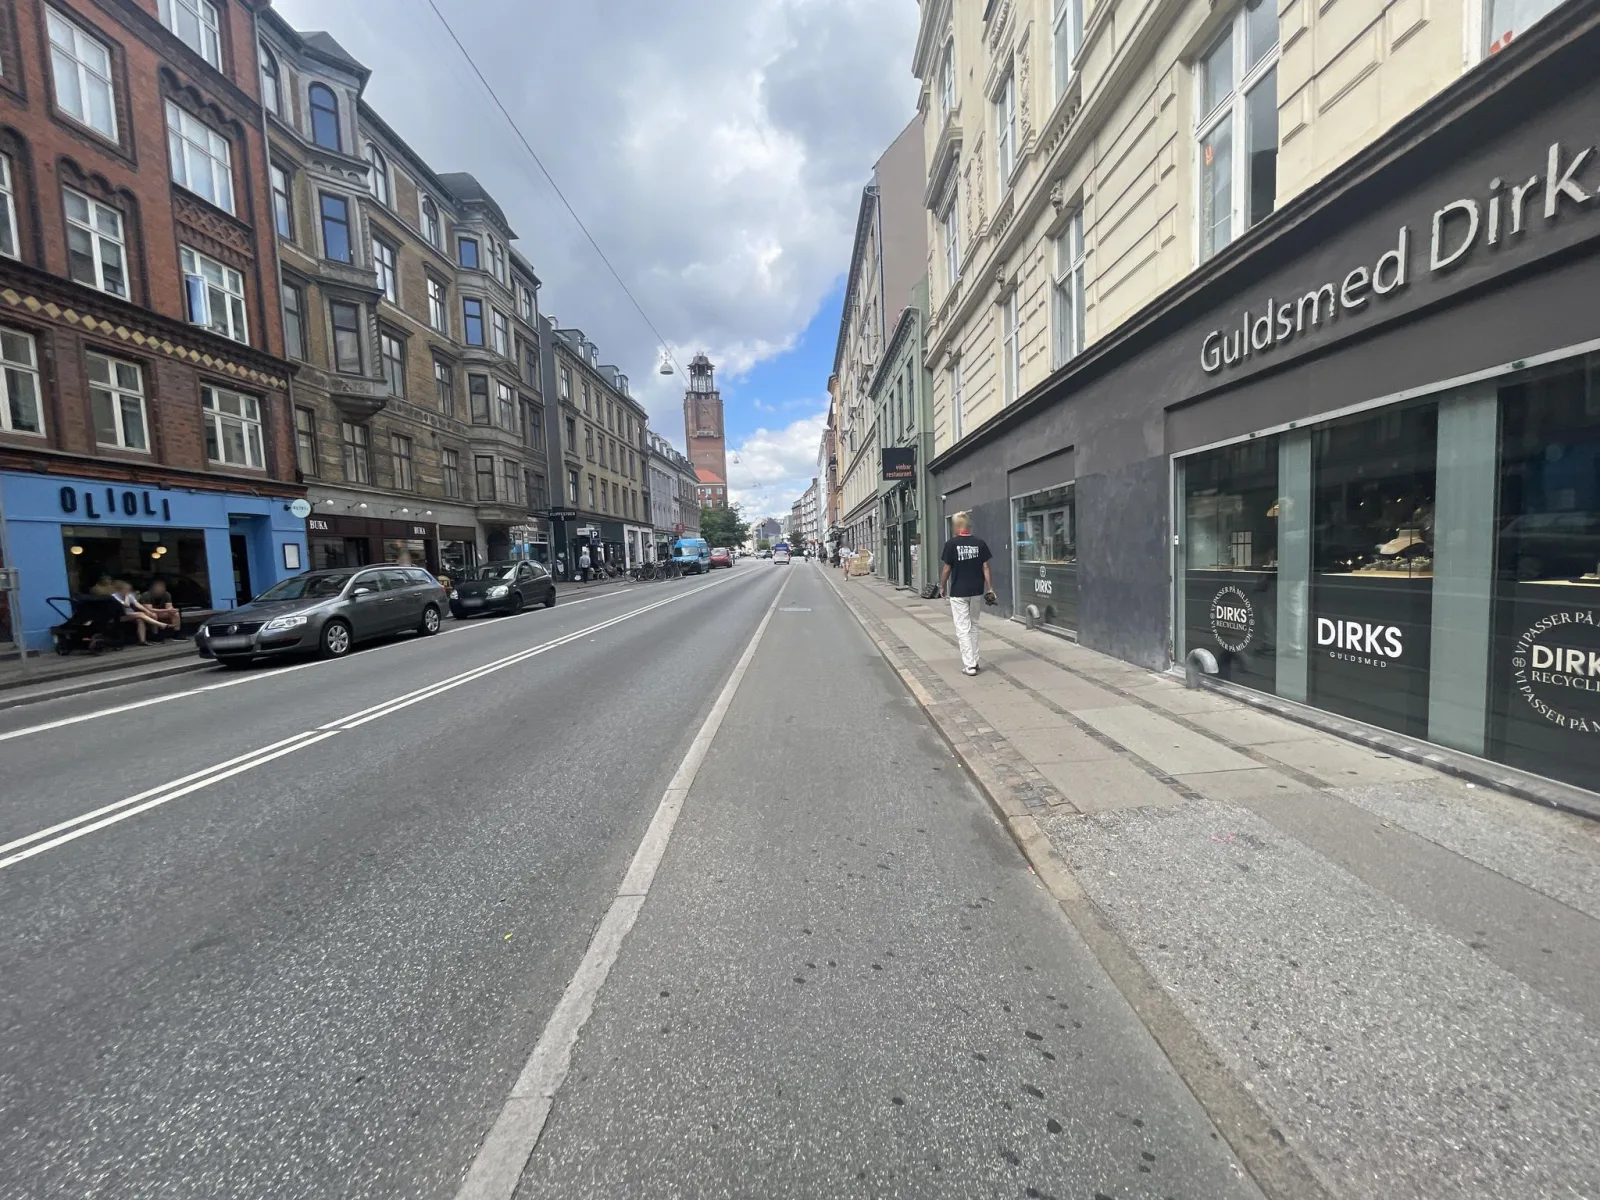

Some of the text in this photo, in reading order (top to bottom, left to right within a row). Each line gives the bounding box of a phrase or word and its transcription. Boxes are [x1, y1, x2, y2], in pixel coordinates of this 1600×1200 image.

[1200, 142, 1600, 373] Guldsmed Dirk
[60, 486, 171, 521] OLIOLI
[309, 520, 328, 530] BUKA
[413, 526, 426, 535] BUKA
[1035, 579, 1052, 594] DIRKS
[1216, 605, 1247, 623] DIRKS
[1216, 620, 1247, 631] RECYCLING
[1514, 610, 1594, 654] VI PASSER PÅ
[1317, 617, 1403, 658] DIRKS
[1329, 651, 1387, 668] GULDSMED
[1514, 670, 1528, 684] VI
[1520, 685, 1566, 726] PASSER
[1569, 718, 1590, 732] PÅ
